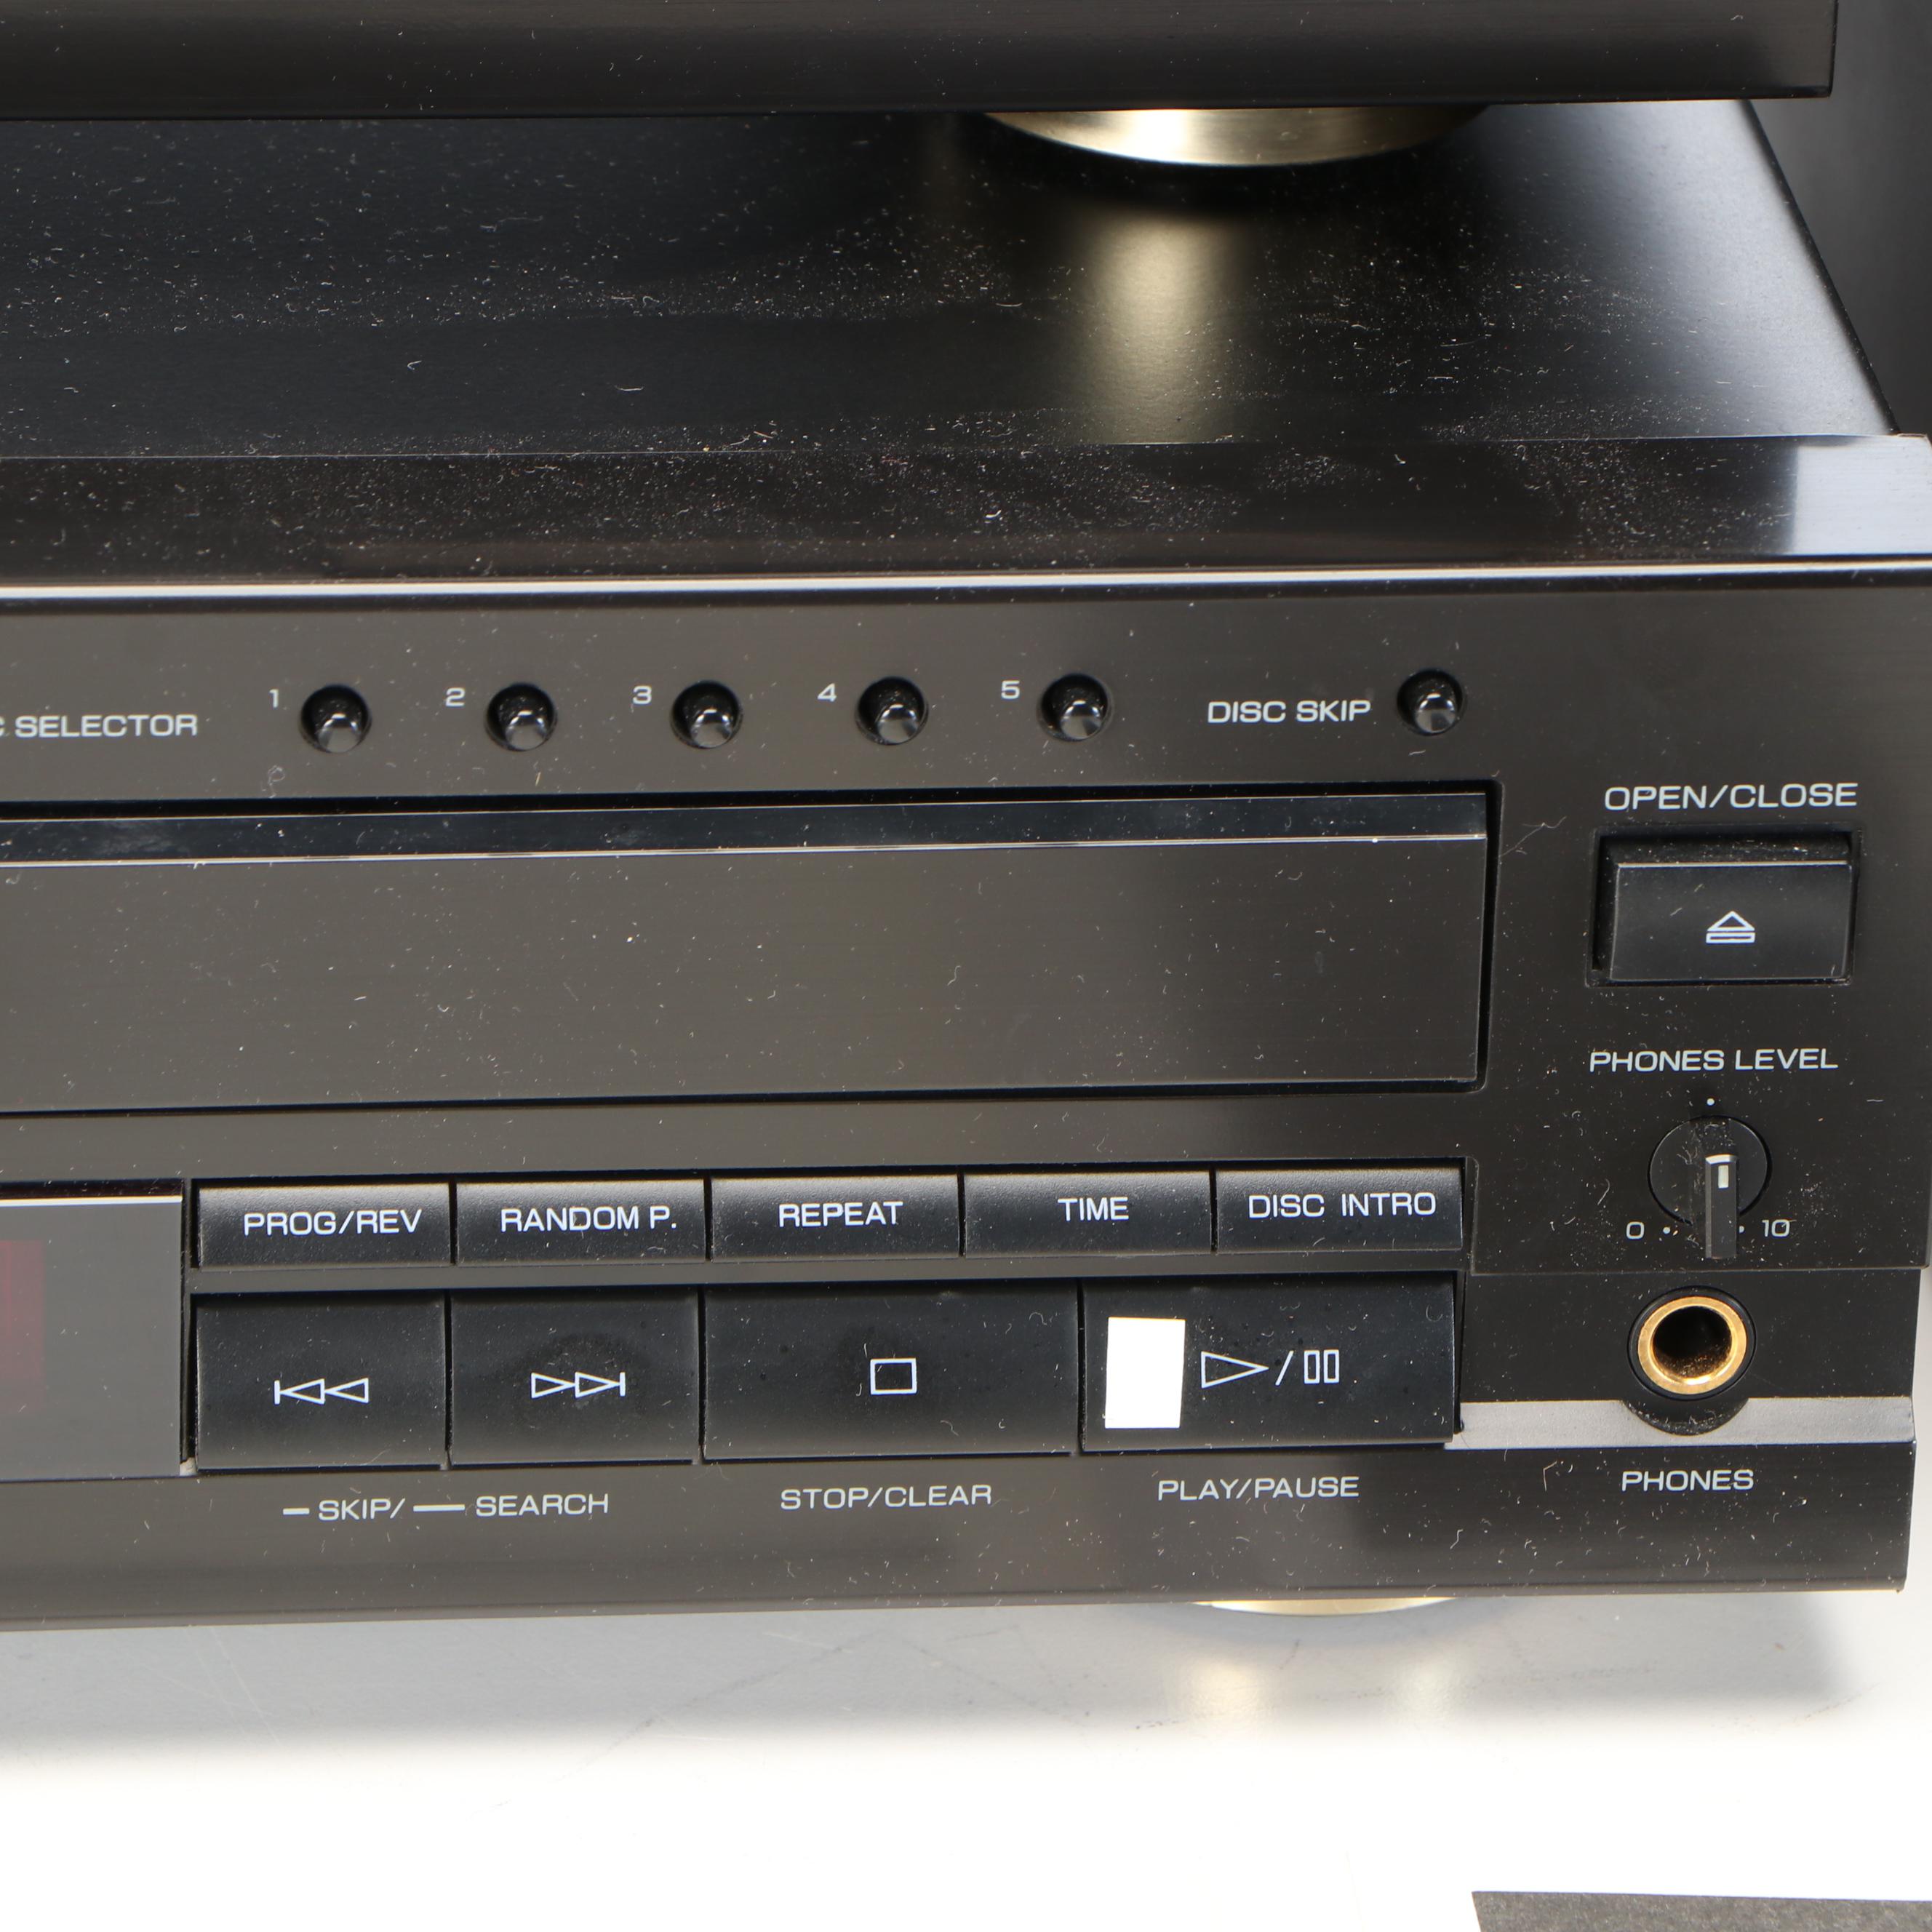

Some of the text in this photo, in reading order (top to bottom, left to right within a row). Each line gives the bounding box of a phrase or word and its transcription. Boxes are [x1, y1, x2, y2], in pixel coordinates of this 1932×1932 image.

[269, 689, 279, 708] 1
[445, 687, 466, 707] 2
[633, 685, 652, 705] 3
[817, 683, 837, 702] 4
[1001, 680, 1020, 699] 5
[1208, 700, 1371, 723] DISC SKIP
[15, 714, 197, 738] SELECTOR
[1605, 783, 1859, 810] OPEN/CLOSE
[1589, 1048, 1838, 1072] PHONES LEVEL
[779, 1201, 903, 1227] REPEAT
[1057, 1197, 1129, 1221] TIME
[1248, 1191, 1436, 1218] DISC INTRO
[244, 1208, 422, 1236] PROG/REV
[501, 1205, 676, 1232] RANDOM P.
[1626, 1221, 1645, 1240] 0
[1762, 1219, 1790, 1237] 10
[1158, 1476, 1359, 1501] PLAY/PAUSE
[1621, 1469, 1754, 1491] PHONES
[476, 1493, 608, 1517] SEARCH
[781, 1484, 991, 1509] STOP/CLEAR
